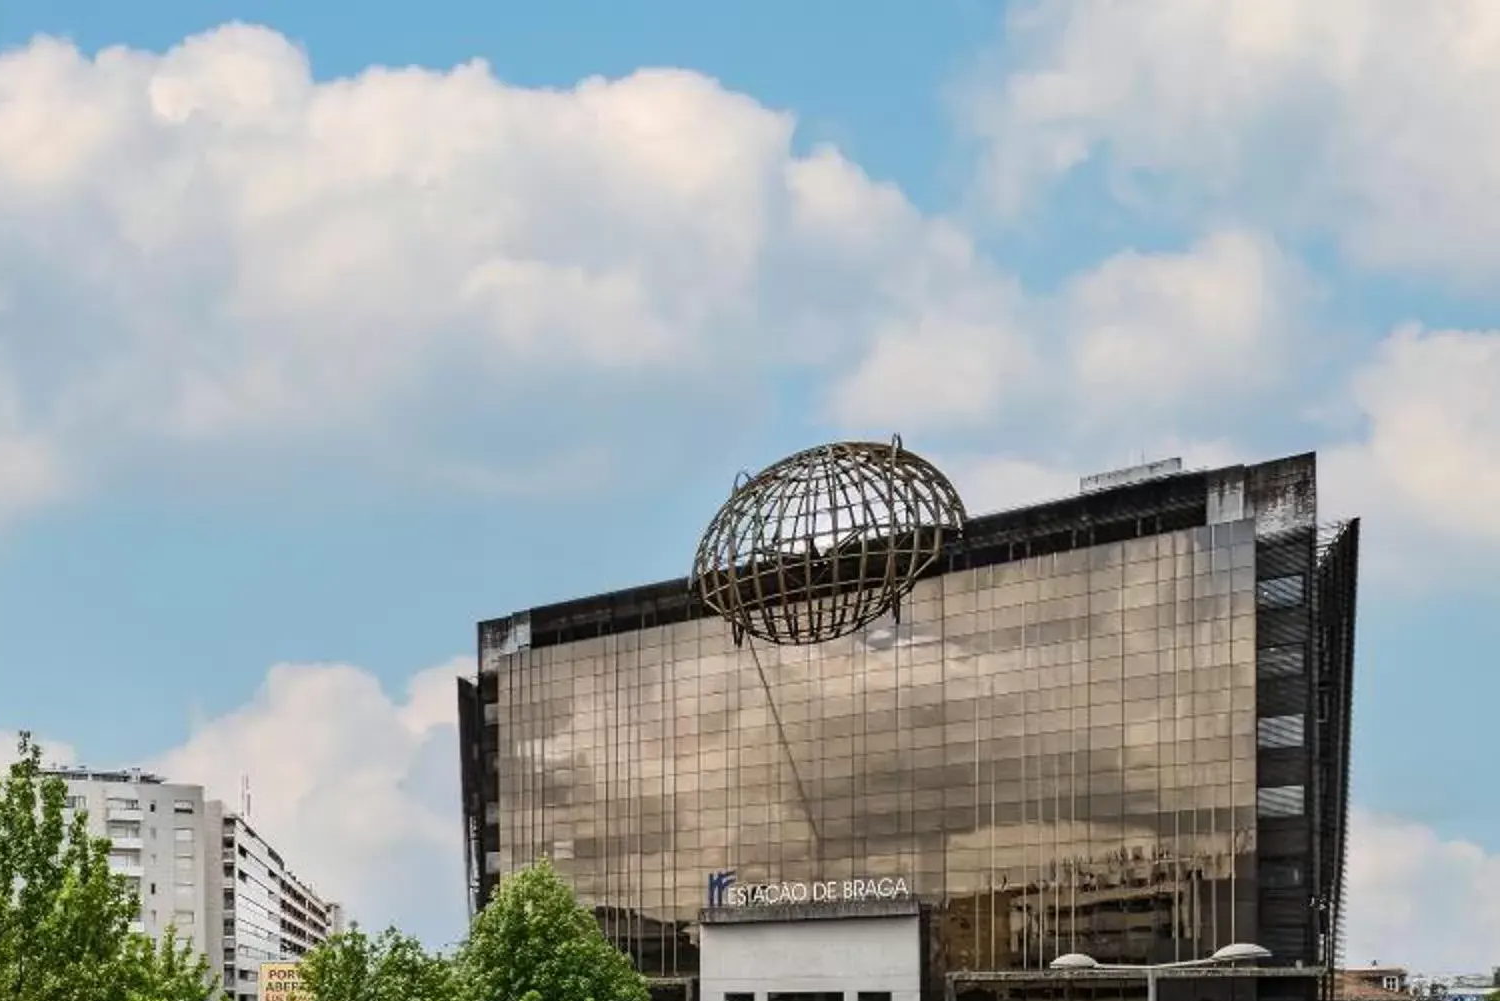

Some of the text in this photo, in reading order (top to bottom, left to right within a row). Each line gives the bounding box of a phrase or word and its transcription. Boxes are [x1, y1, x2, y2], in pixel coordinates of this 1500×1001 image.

[727, 877, 909, 905] ESTAÇÃO DE BRAGA
